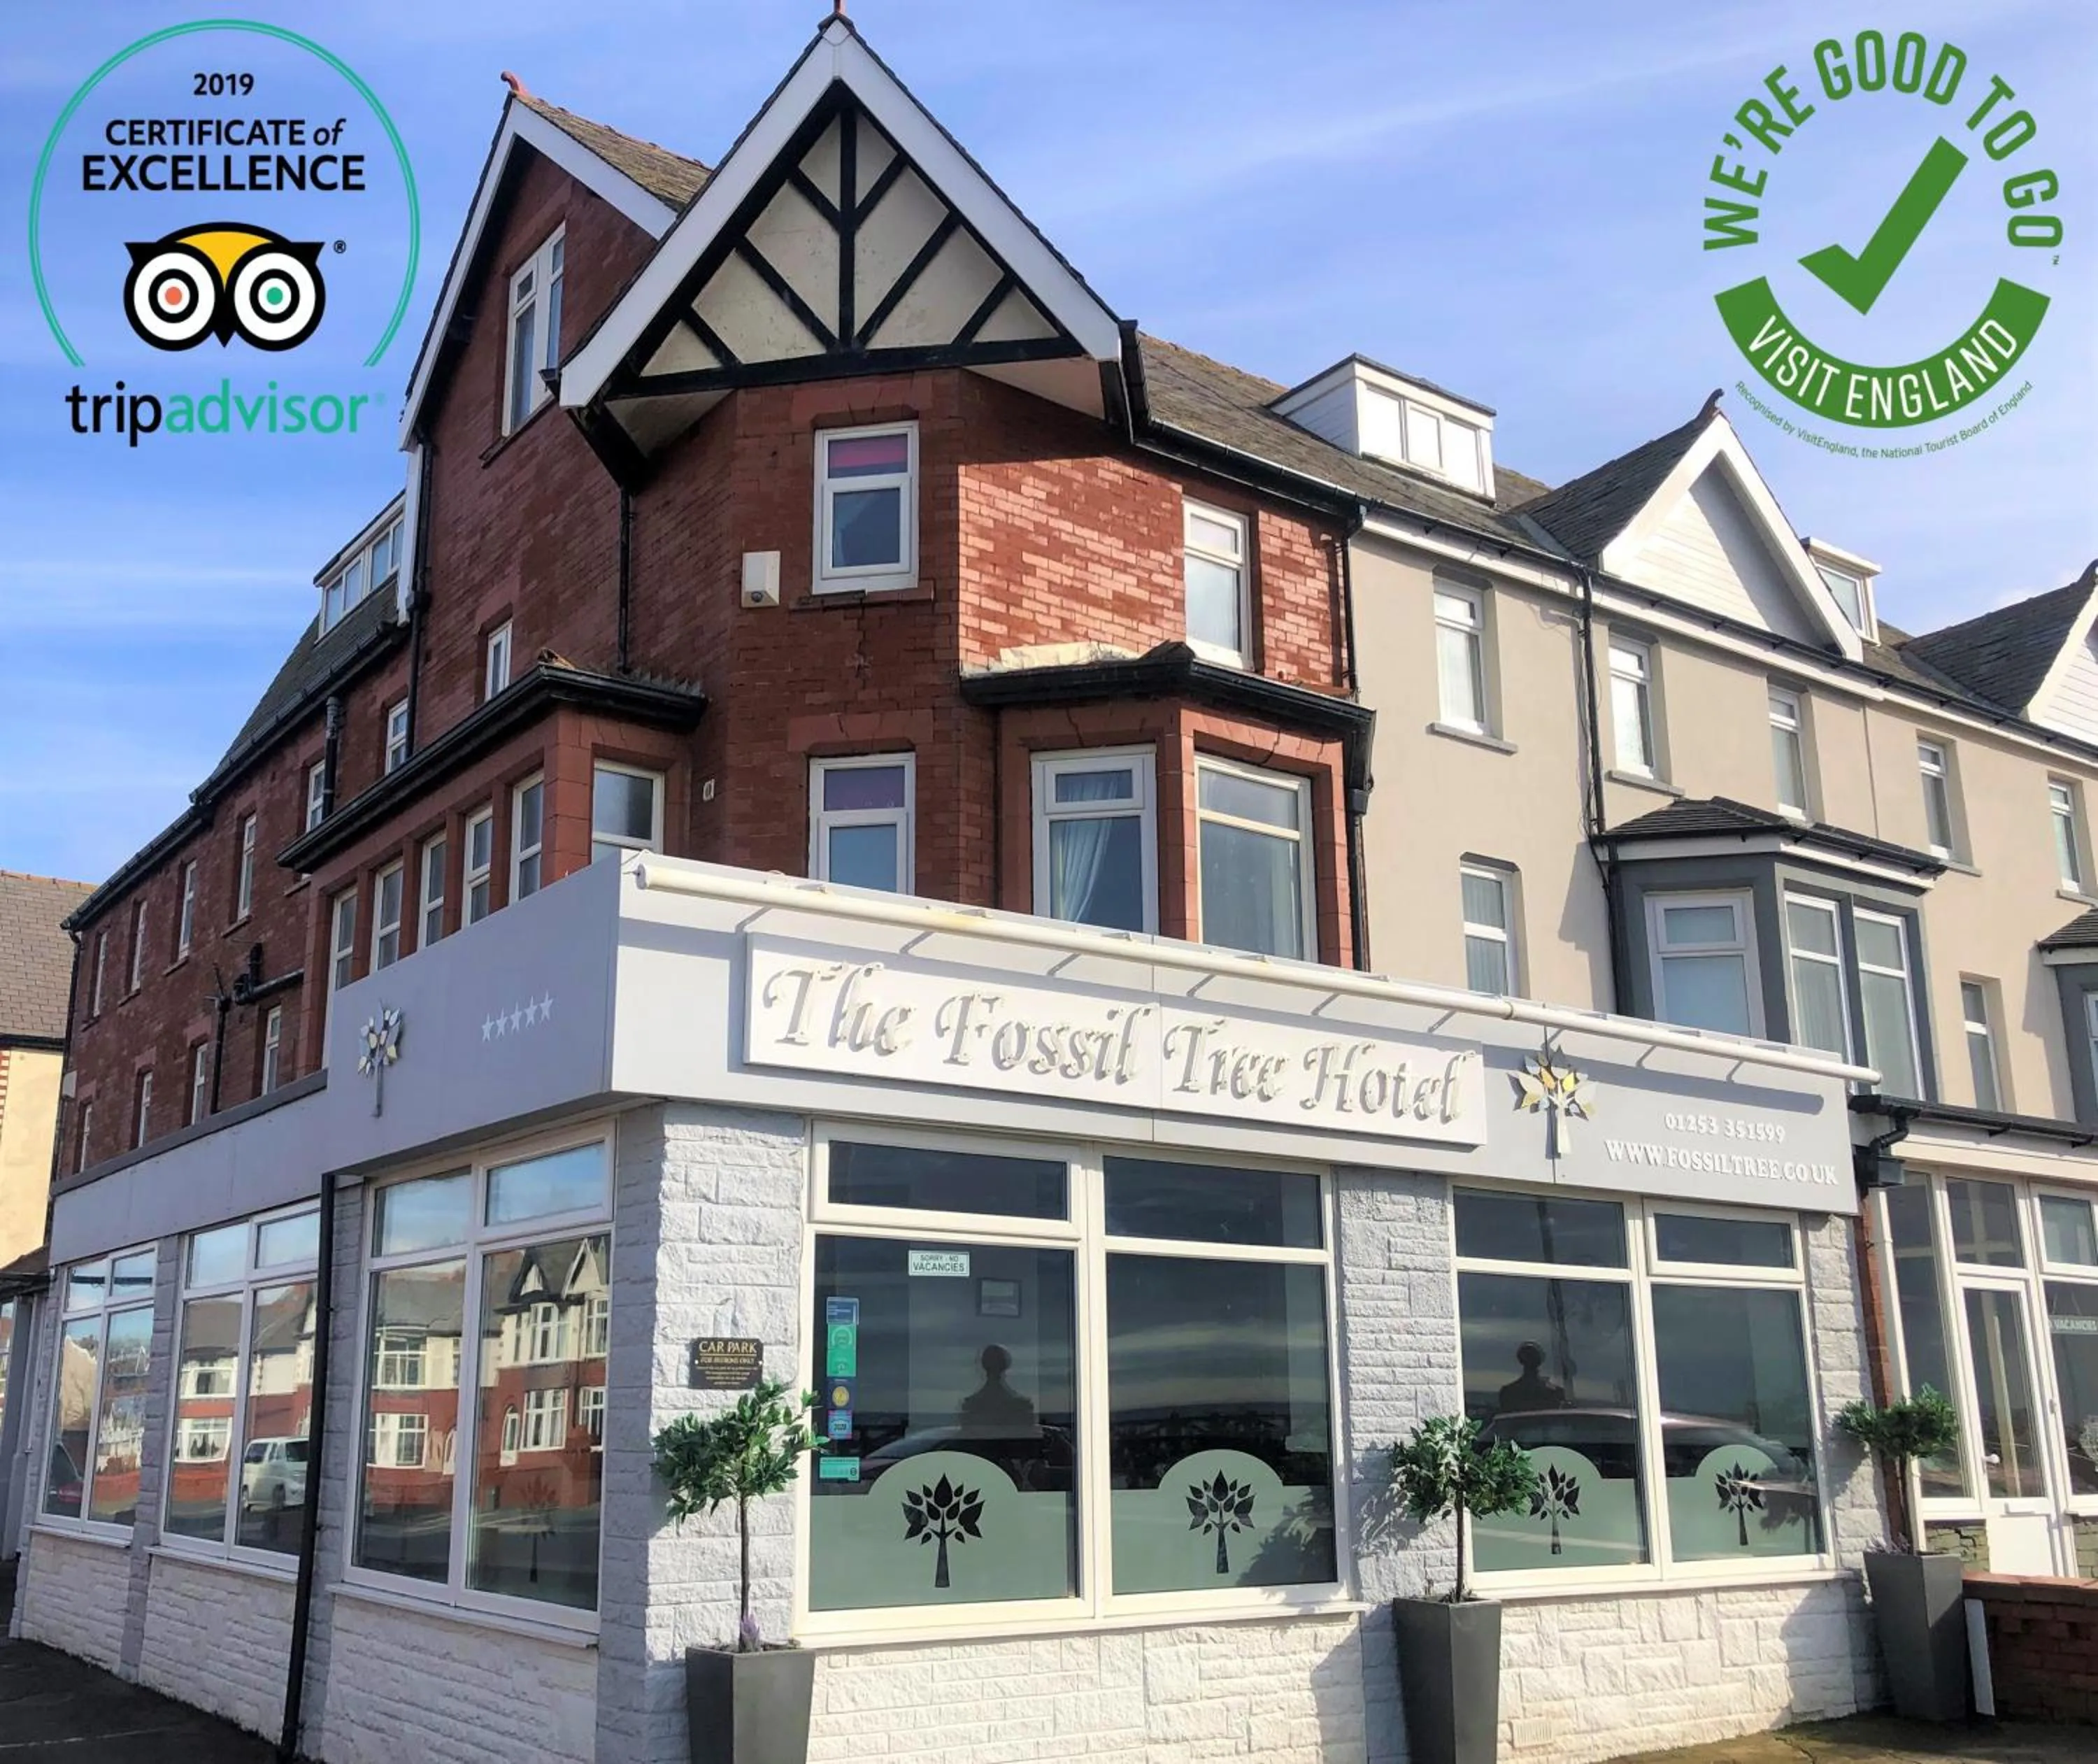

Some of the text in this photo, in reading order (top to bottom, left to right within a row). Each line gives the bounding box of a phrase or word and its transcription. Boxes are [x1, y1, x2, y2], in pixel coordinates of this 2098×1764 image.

[763, 961, 1478, 1125] The Fossil Tree Hotel
[1664, 1112, 1785, 1144] 01253 351599
[913, 1262, 964, 1272] VACANCIES
[699, 1341, 757, 1353] CAR PARK
